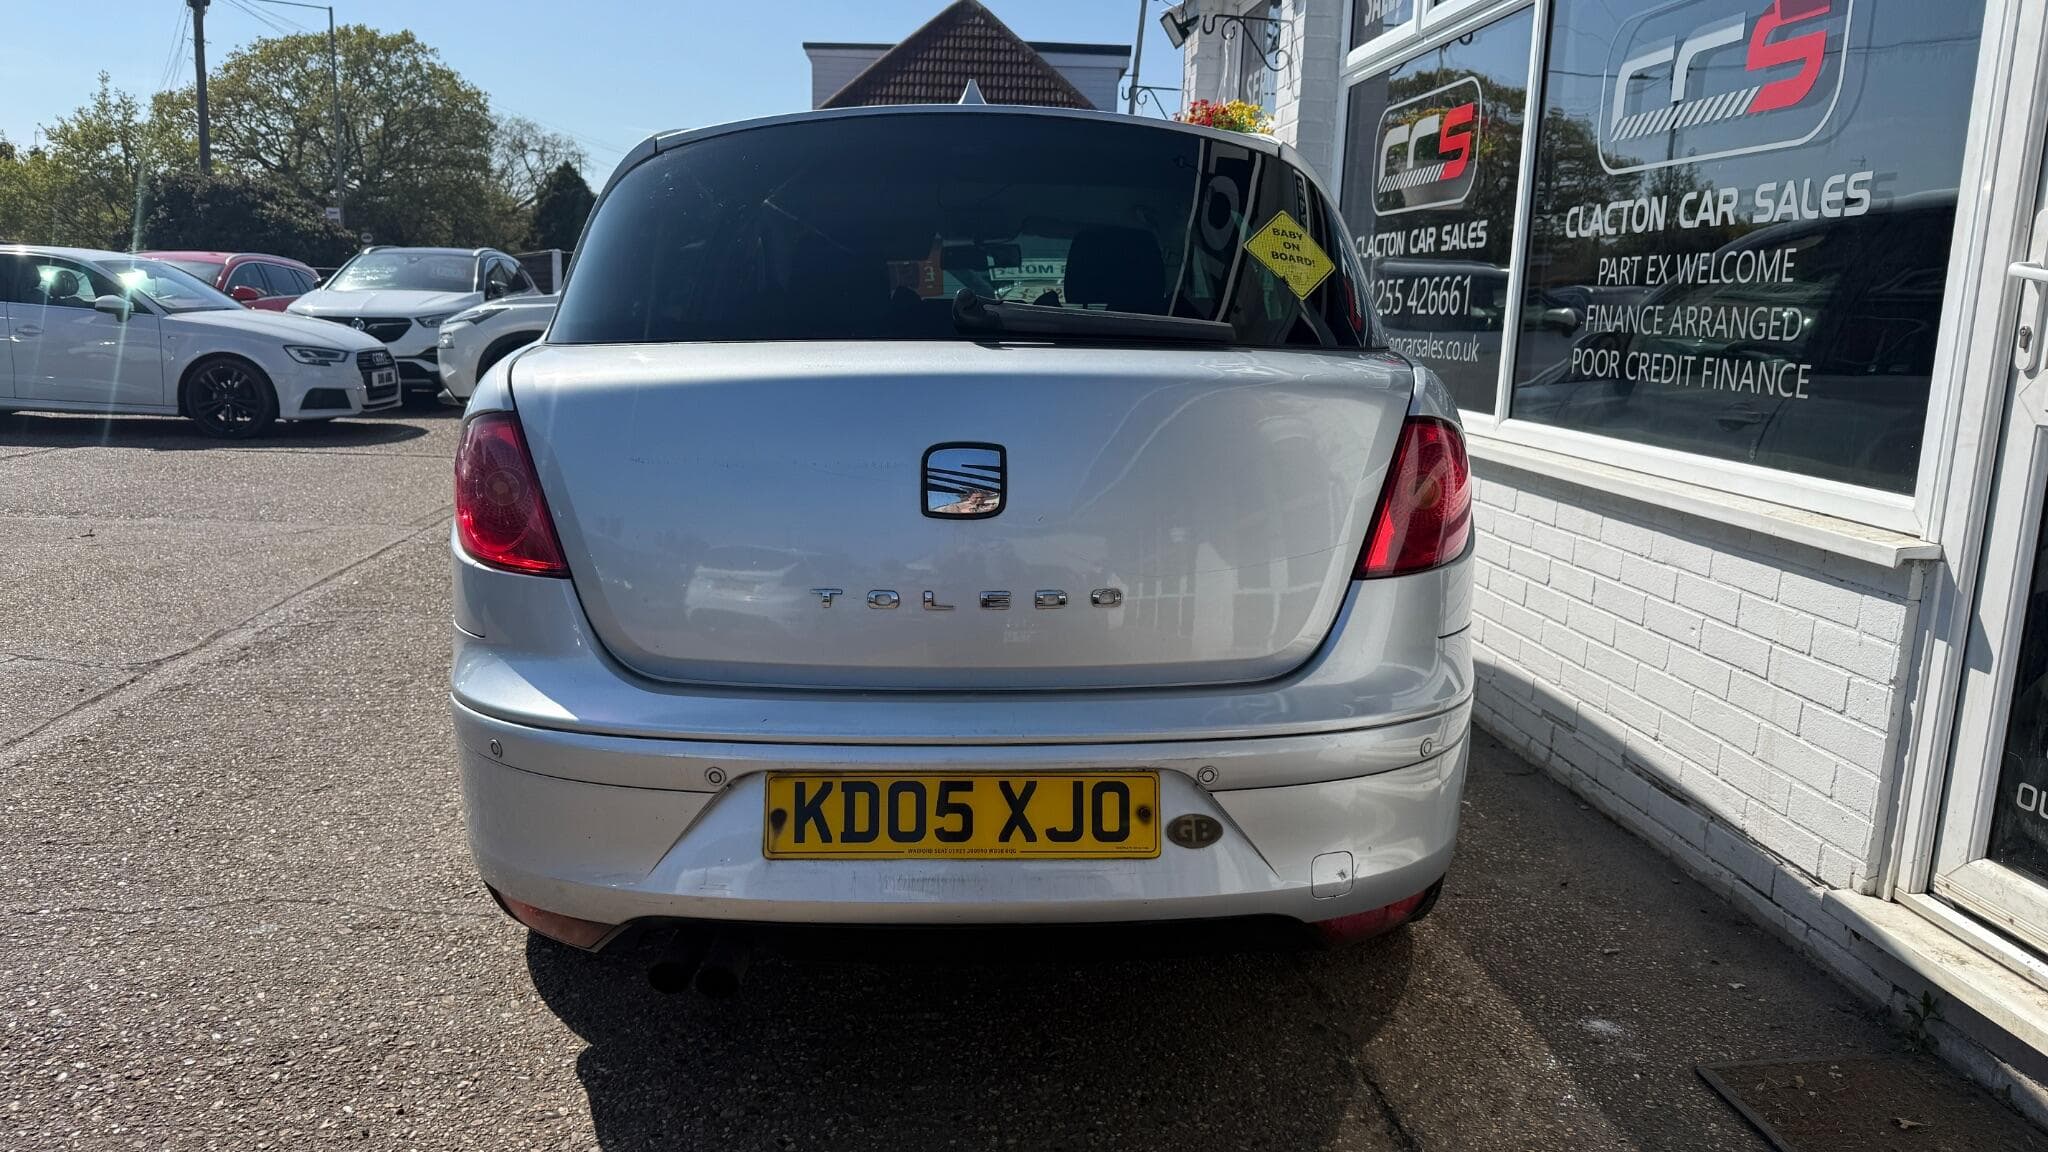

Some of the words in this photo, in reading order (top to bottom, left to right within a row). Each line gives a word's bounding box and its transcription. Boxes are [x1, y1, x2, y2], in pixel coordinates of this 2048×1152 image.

[1565, 196, 1668, 239] CLACTON
[1679, 187, 1739, 229] CAR
[1752, 171, 1873, 223] SALES
[1272, 228, 1303, 240] BABY
[1283, 241, 1300, 252] ON
[1355, 230, 1406, 258] CLACTON
[1409, 226, 1437, 255] CAR
[1441, 220, 1489, 251] SALES
[1271, 251, 1315, 268] BOARD!
[1598, 256, 1642, 285] PART
[1646, 254, 1671, 285] EX
[1676, 248, 1797, 284] WELCOME
[1407, 275, 1472, 316] 426661
[1585, 304, 1664, 335] FINANCE
[1669, 306, 1802, 342] ARRANGED
[1571, 348, 1619, 378] POOR
[1625, 351, 1696, 386] CREDIT
[1701, 357, 1812, 399] FINANCE
[809, 588, 1122, 610] TOLEDO
[793, 780, 974, 843] KD05
[998, 780, 1131, 843] XJO
